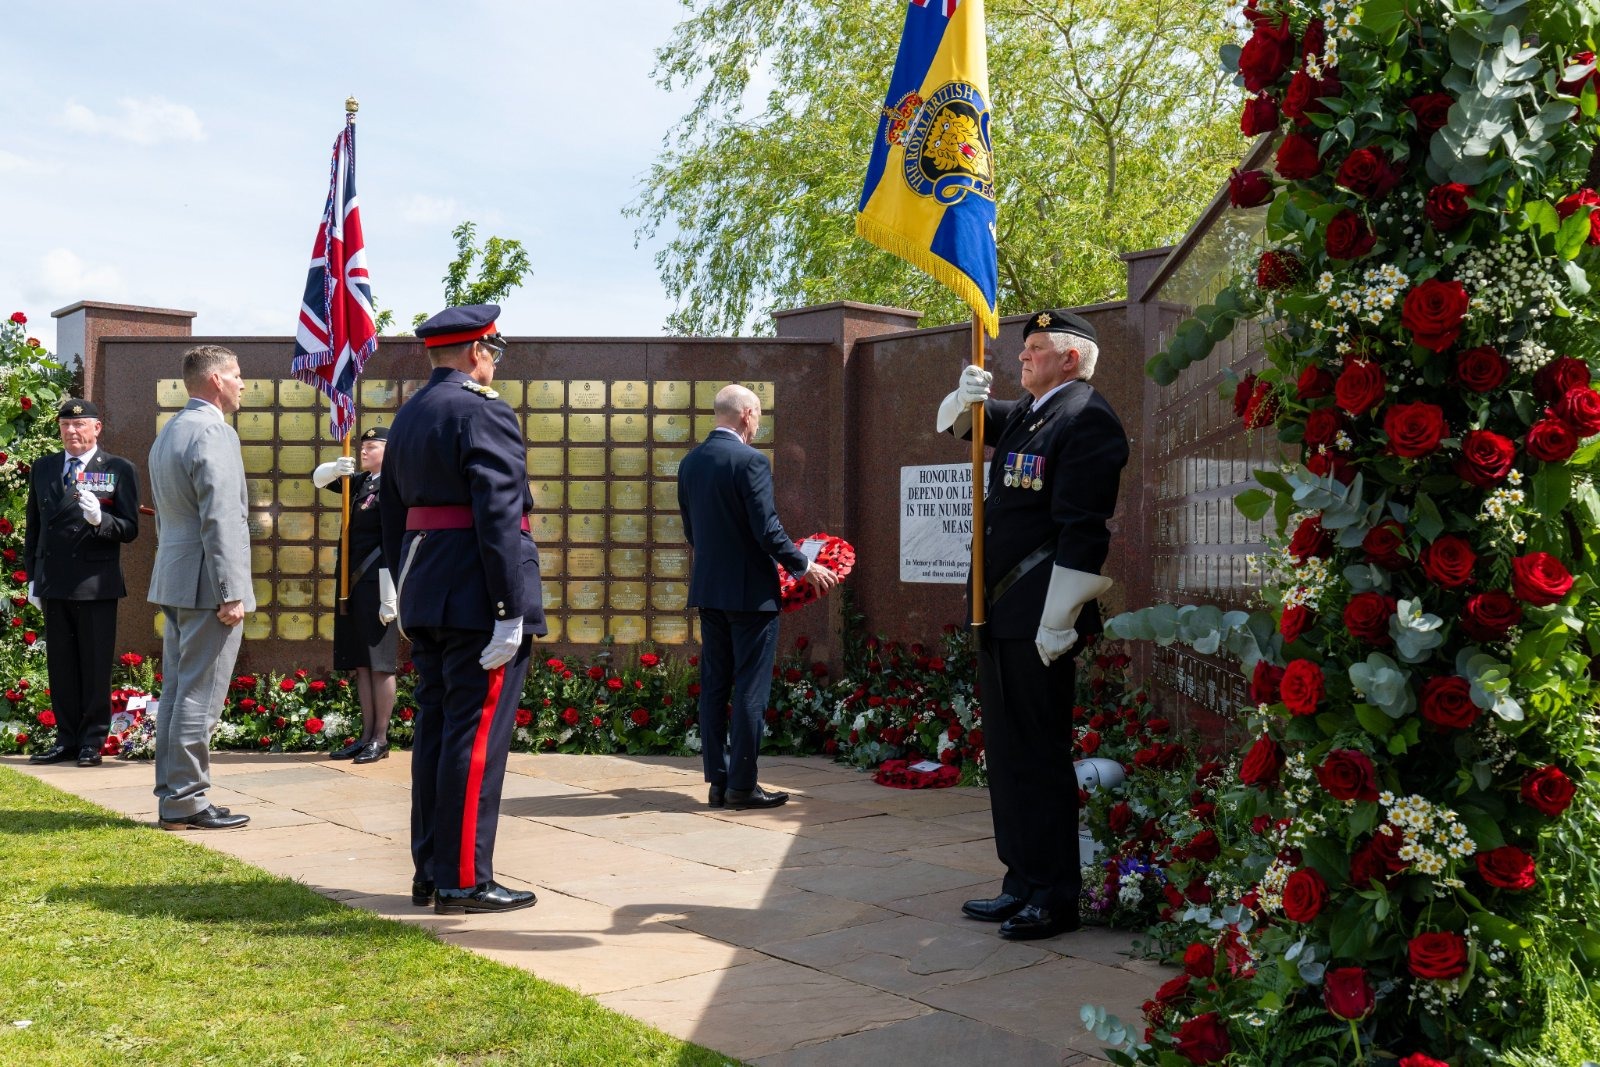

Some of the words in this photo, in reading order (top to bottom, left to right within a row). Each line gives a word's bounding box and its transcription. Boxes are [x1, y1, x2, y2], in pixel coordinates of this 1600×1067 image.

[925, 83, 974, 115] BRITISH
[906, 116, 931, 164] ROYAL
[906, 164, 925, 192] THE
[971, 178, 994, 198] LEG
[908, 486, 943, 500] DEPEND
[945, 486, 959, 500] ON
[906, 503, 915, 517] IS
[917, 503, 936, 517] THE
[938, 502, 973, 517] NUMBE
[942, 519, 973, 534] MEASU
[912, 559, 931, 568] Memory
[939, 559, 955, 567] British
[945, 570, 967, 578] coalition
